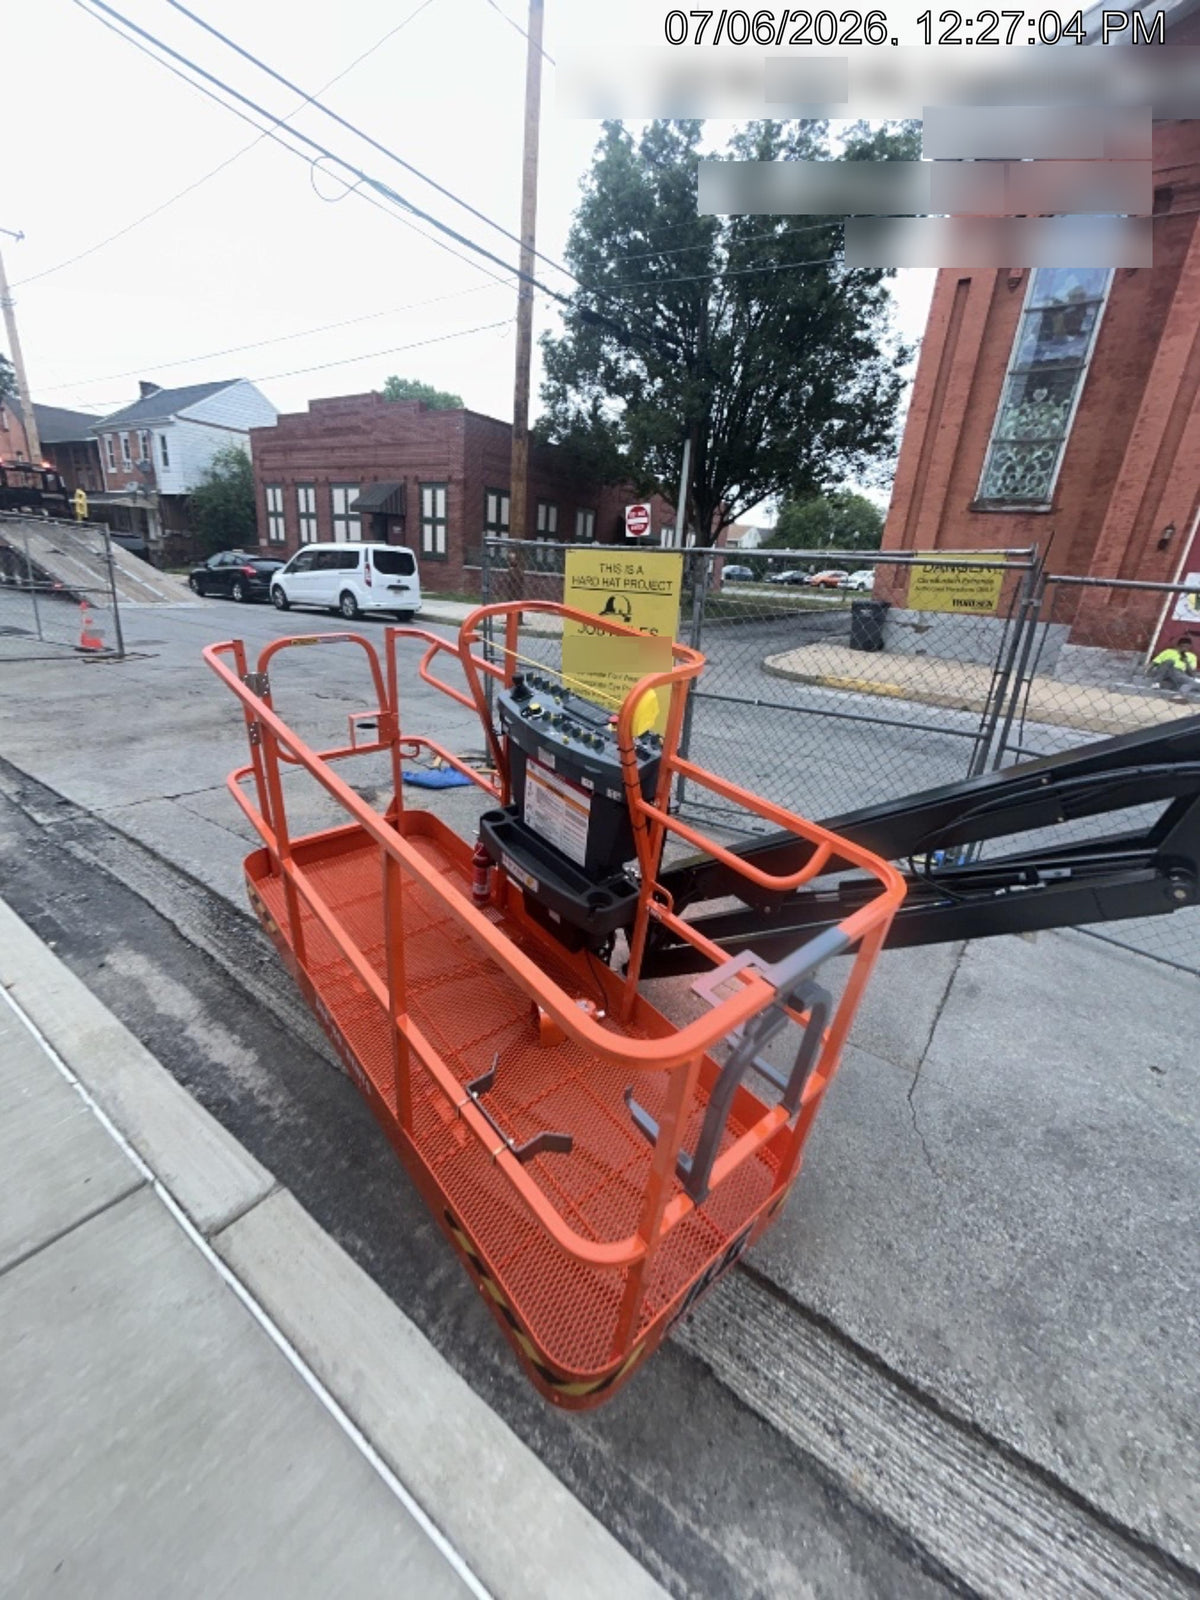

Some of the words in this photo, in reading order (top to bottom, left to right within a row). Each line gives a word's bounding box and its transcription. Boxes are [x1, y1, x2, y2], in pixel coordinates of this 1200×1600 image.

[600, 563, 622, 574] THIS
[625, 565, 634, 575] IS
[637, 565, 645, 575] A
[571, 575, 600, 586] HARD
[602, 577, 621, 587] HAT
[623, 579, 673, 591] PROJECT
